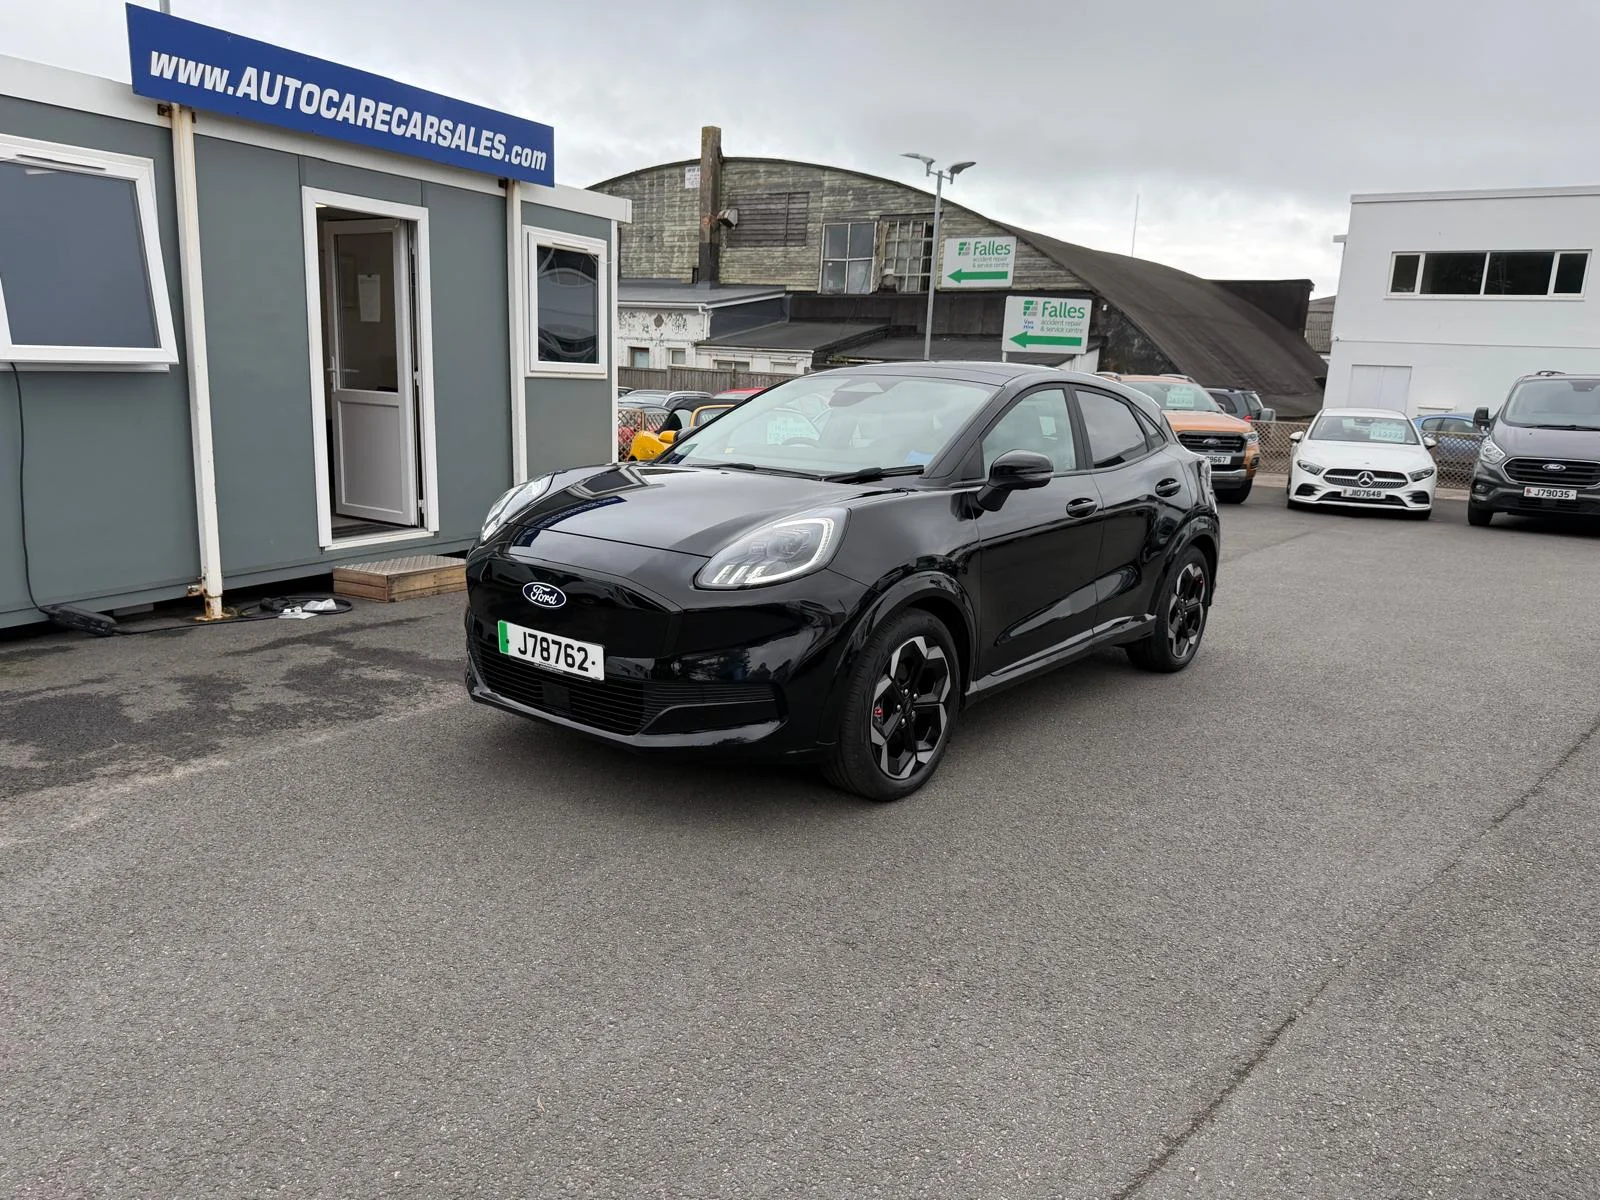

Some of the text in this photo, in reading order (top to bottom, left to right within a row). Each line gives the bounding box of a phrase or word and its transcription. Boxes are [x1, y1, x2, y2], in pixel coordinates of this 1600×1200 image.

[150, 50, 547, 171] www.AUTOCARECARSALES.com
[973, 240, 1011, 256] Falles
[1041, 300, 1085, 319] Falles
[1534, 489, 1570, 499] J79035
[529, 584, 557, 605] Ford
[518, 631, 589, 672] J78762
